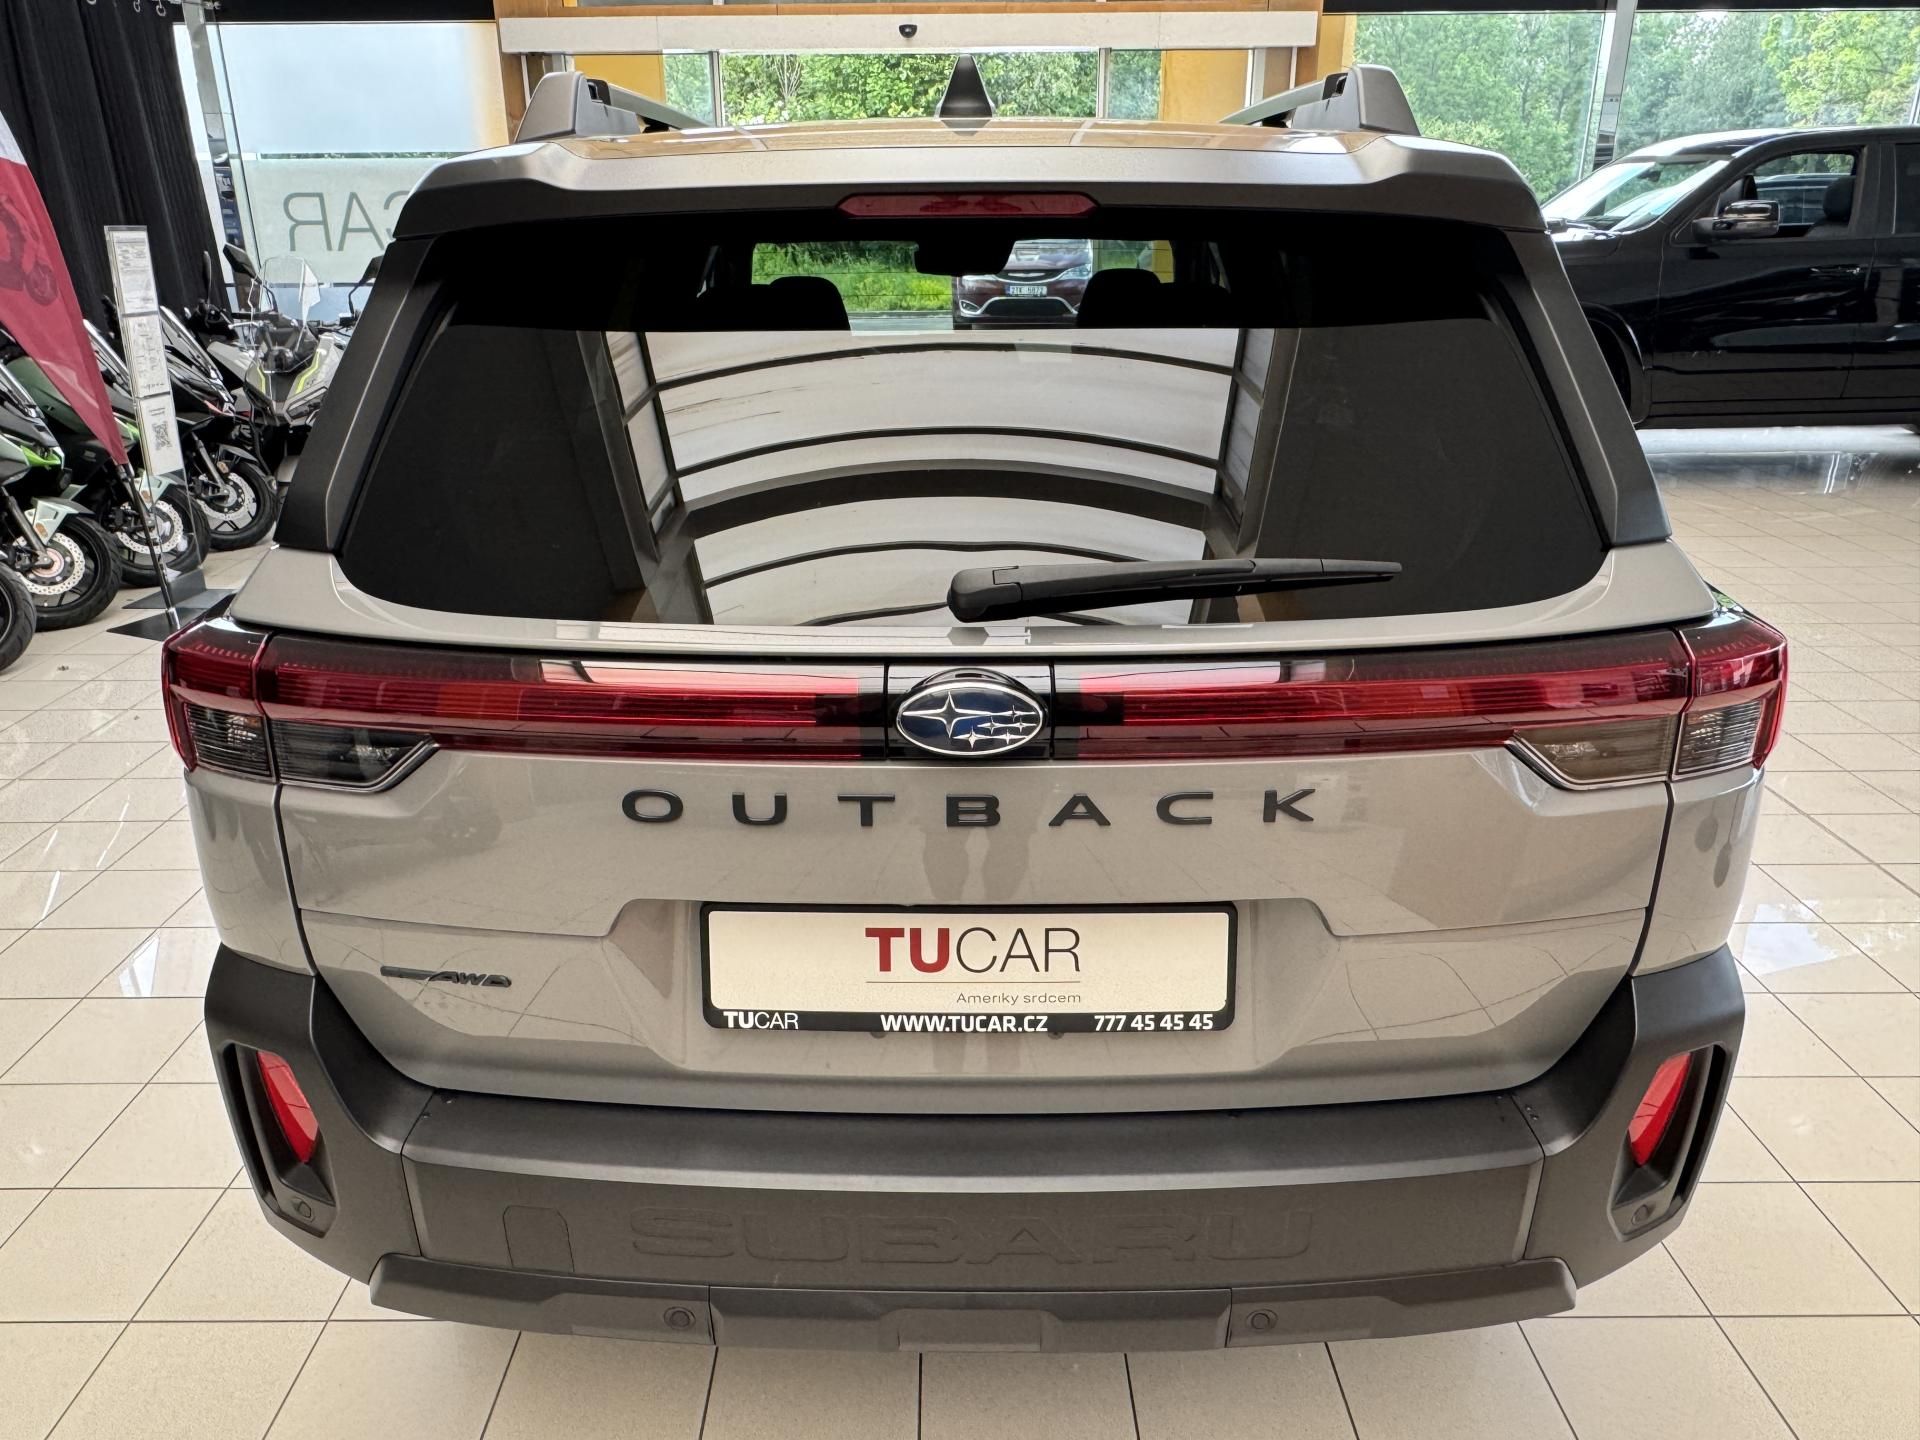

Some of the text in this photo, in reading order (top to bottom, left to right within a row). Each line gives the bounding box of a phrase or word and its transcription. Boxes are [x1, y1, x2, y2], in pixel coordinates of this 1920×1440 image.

[621, 788, 1316, 828] OUTBACK
[865, 927, 1081, 973] TUCAR
[429, 970, 512, 988] AWD
[956, 992, 1081, 1005] Ameriky srdcem
[724, 1011, 799, 1030] TUCAR
[880, 1014, 1048, 1032] WWW.TUCAR.CZ
[1094, 1013, 1213, 1031] 777 45 45 45
[629, 1206, 1313, 1265] SUBARU
